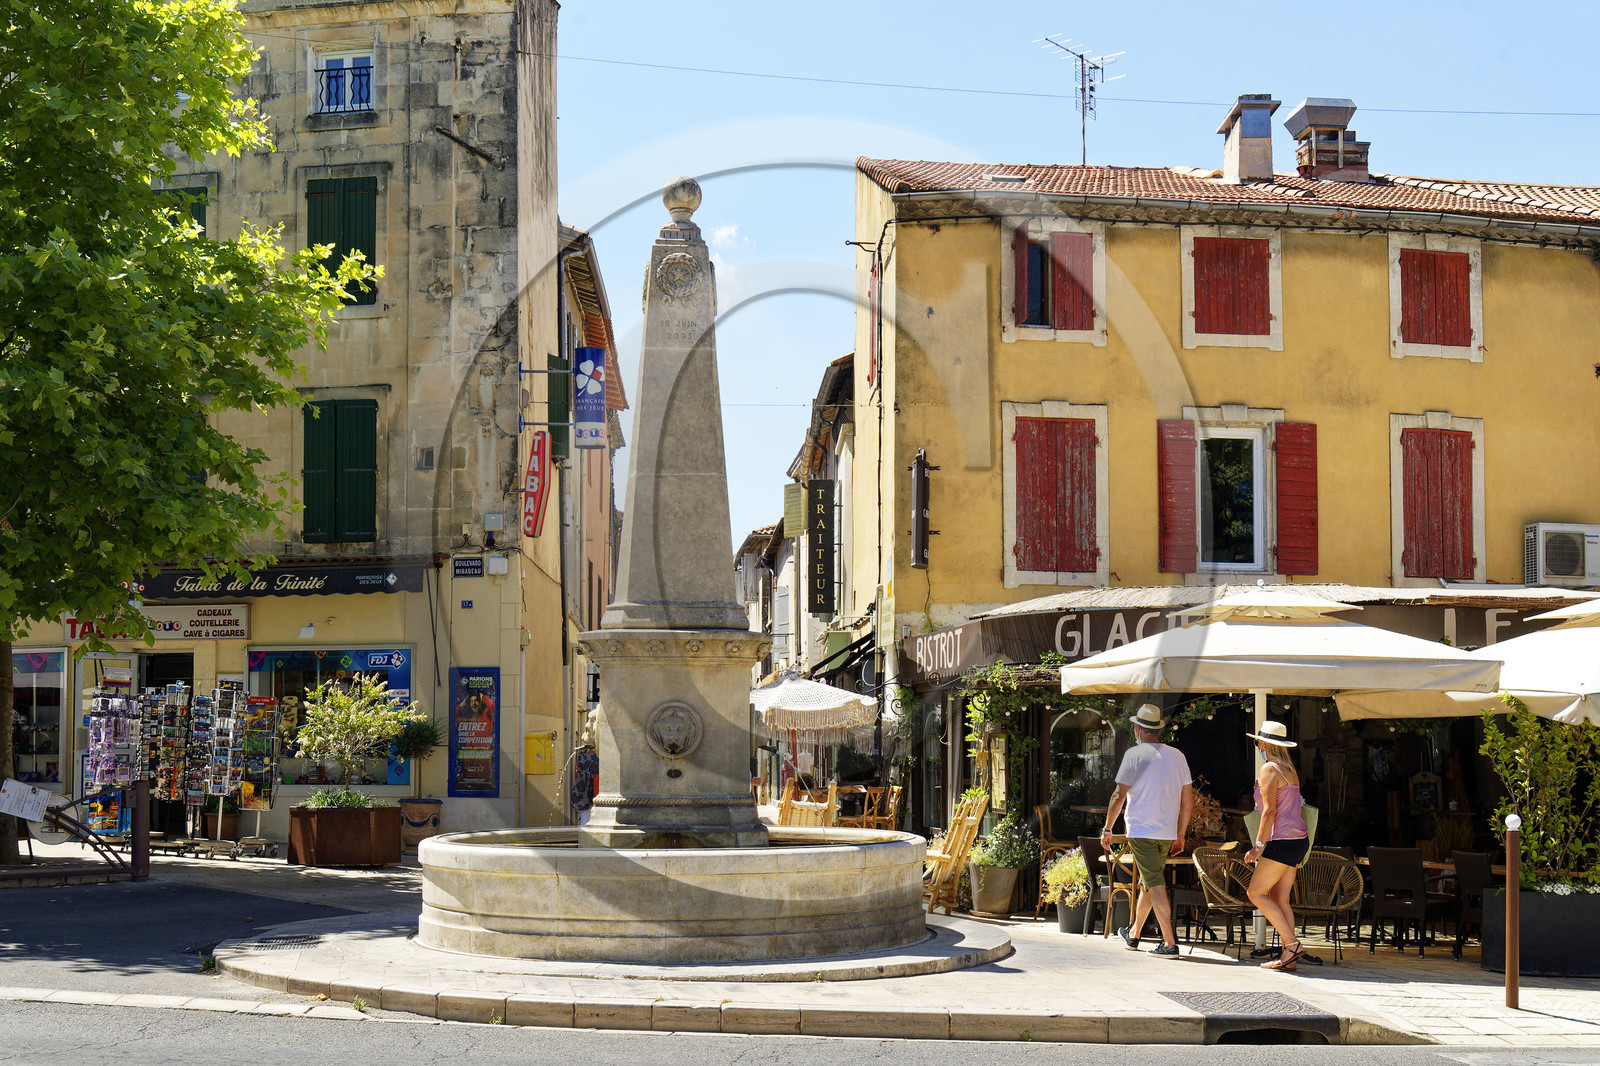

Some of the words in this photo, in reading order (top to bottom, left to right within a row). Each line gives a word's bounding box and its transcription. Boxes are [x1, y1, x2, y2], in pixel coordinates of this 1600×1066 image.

[660, 320, 671, 328] 15
[675, 320, 698, 328] JUIN
[575, 427, 606, 440] LOTO
[523, 434, 542, 532] TABAC
[816, 488, 826, 605] TRAITEUR
[455, 567, 482, 575] MIRABEAU
[173, 575, 222, 592] Tabac
[226, 576, 246, 591] de
[250, 576, 269, 591] la
[273, 573, 329, 591] Trinité
[196, 608, 233, 617] CADEAUX
[189, 618, 240, 628] COUTELLERIE
[183, 629, 203, 638] CAVE
[204, 628, 210, 638] à
[211, 628, 246, 638] CIGARES
[916, 627, 963, 674] BISTROT
[370, 655, 389, 665] FDJ
[457, 722, 487, 732] ENTREZ
